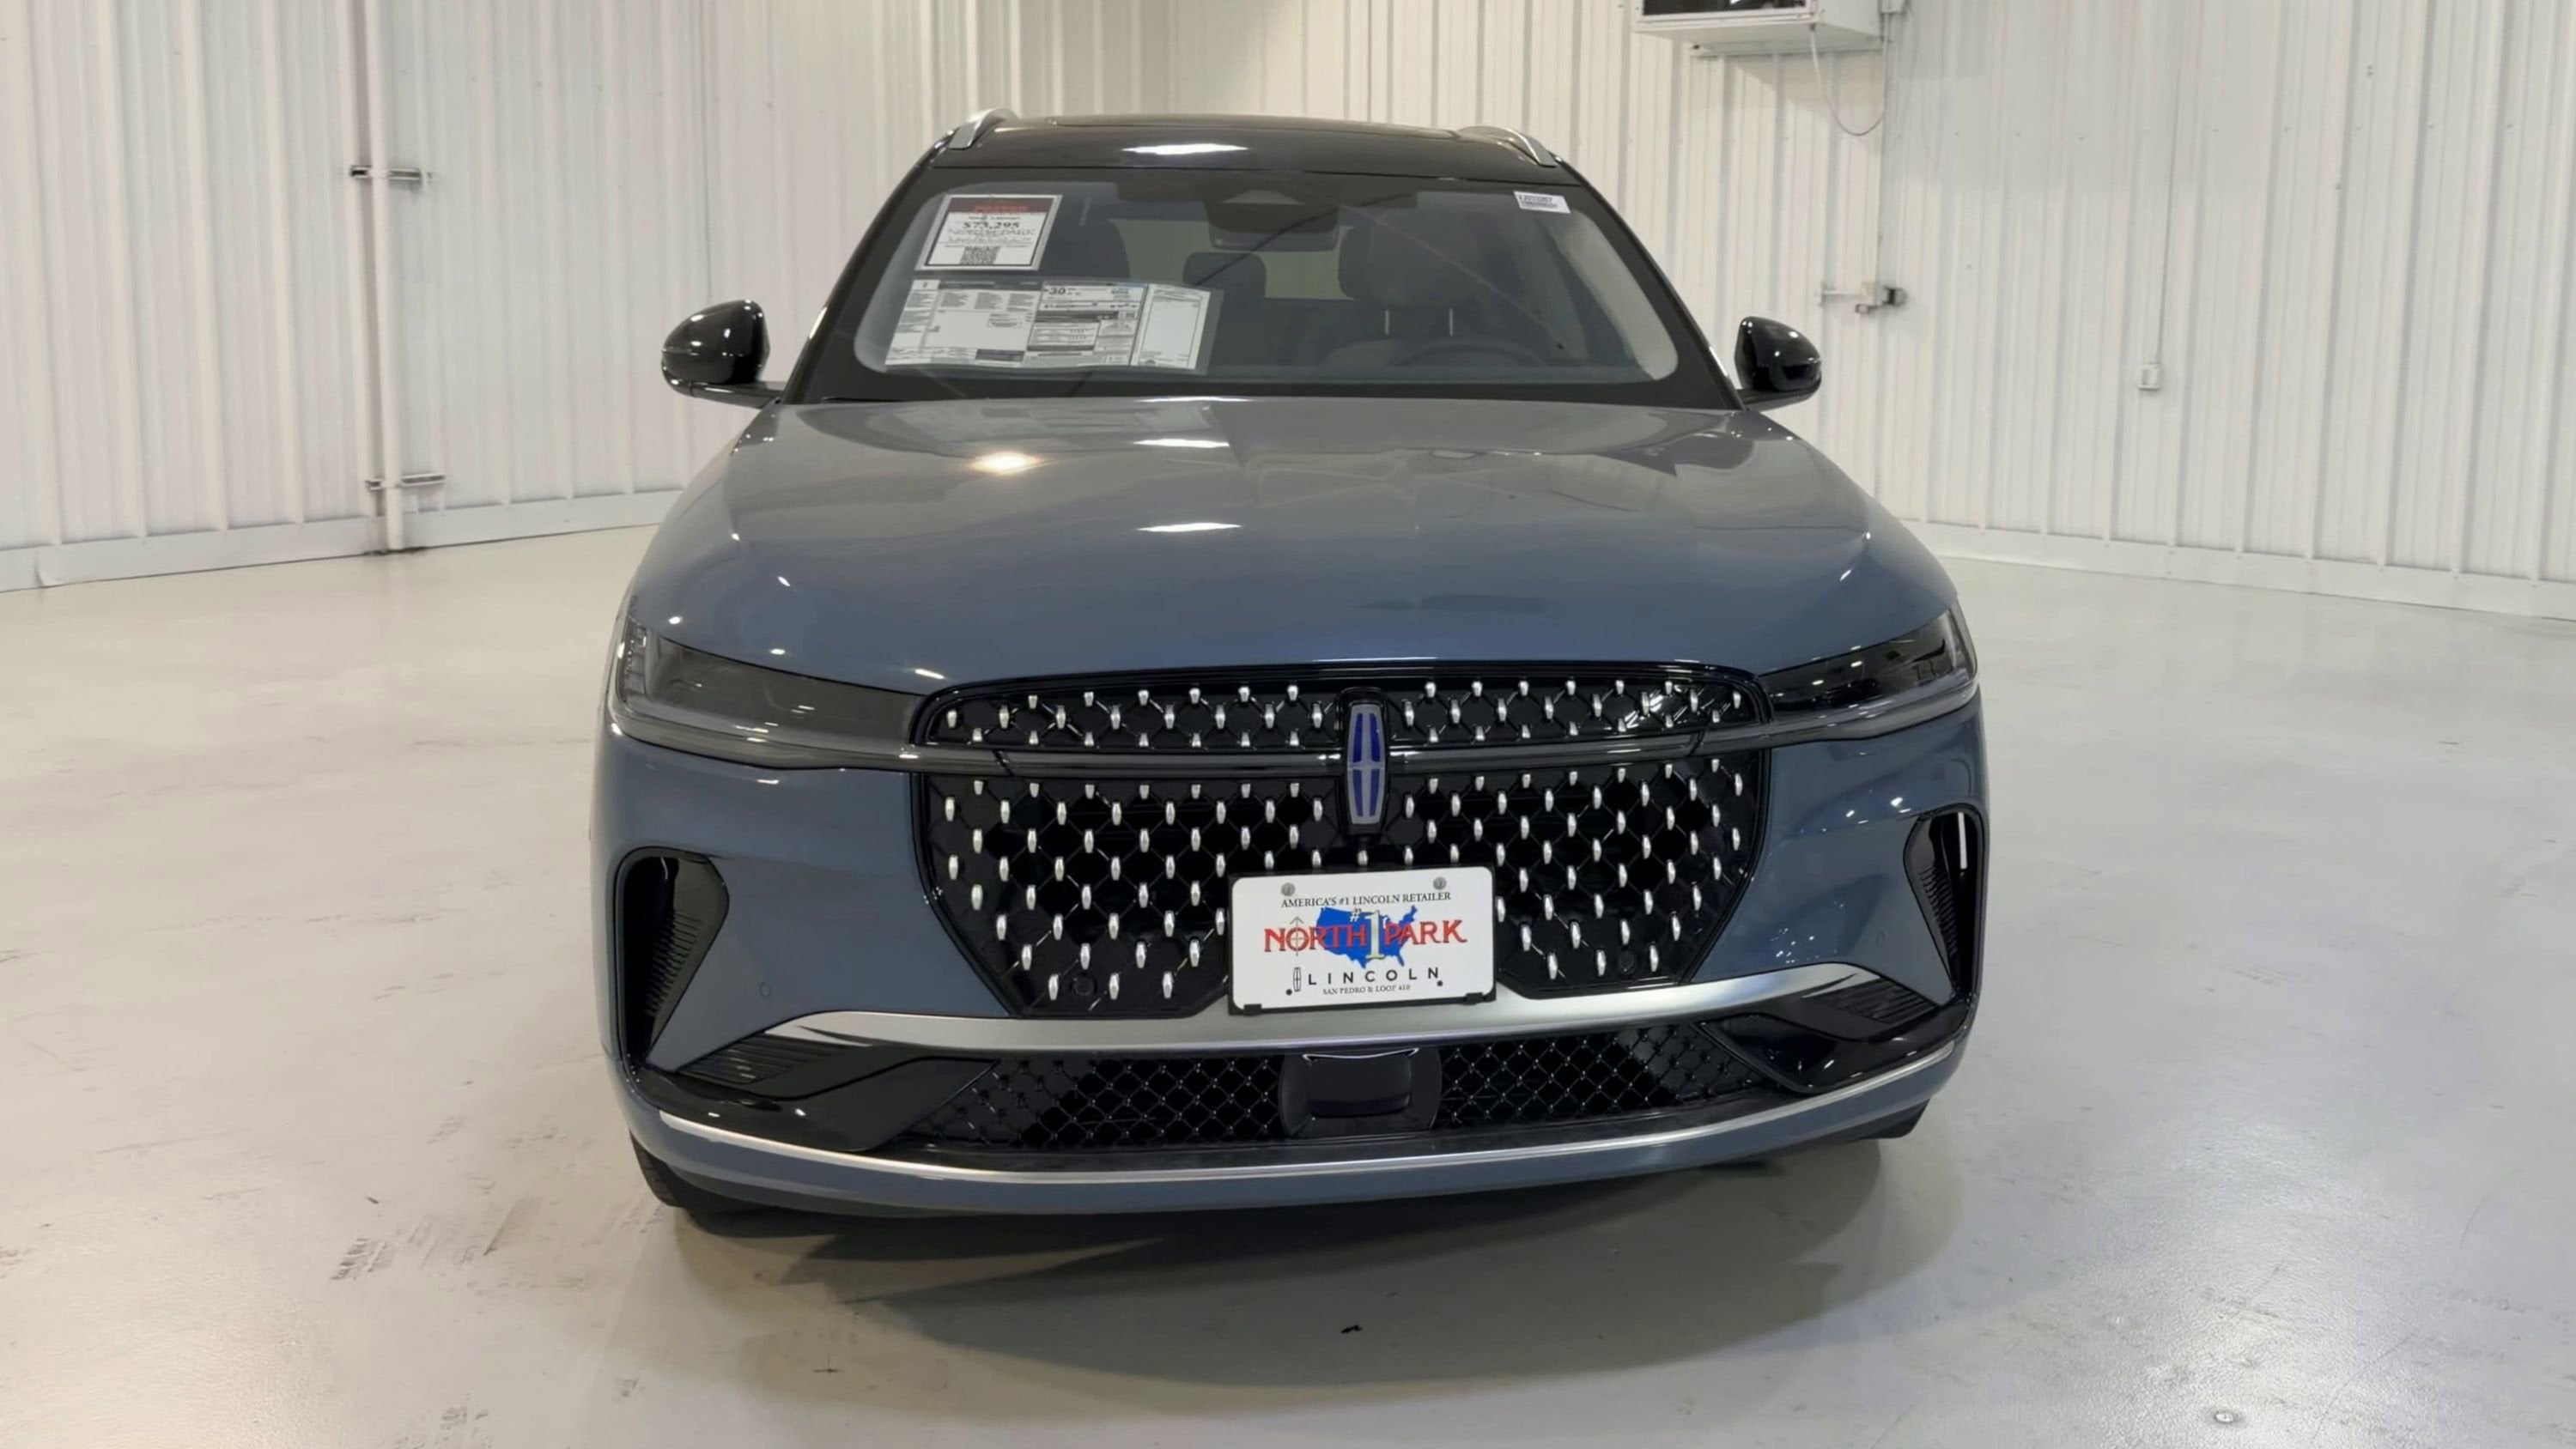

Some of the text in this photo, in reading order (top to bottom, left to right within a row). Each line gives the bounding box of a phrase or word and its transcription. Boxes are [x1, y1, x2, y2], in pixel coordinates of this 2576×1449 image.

[1281, 892, 1451, 908] AMERICA'S #1 LINCOLN RETAILER
[1264, 919, 1468, 953] NORTH PARK
[1308, 967, 1439, 985] LINCOLN
